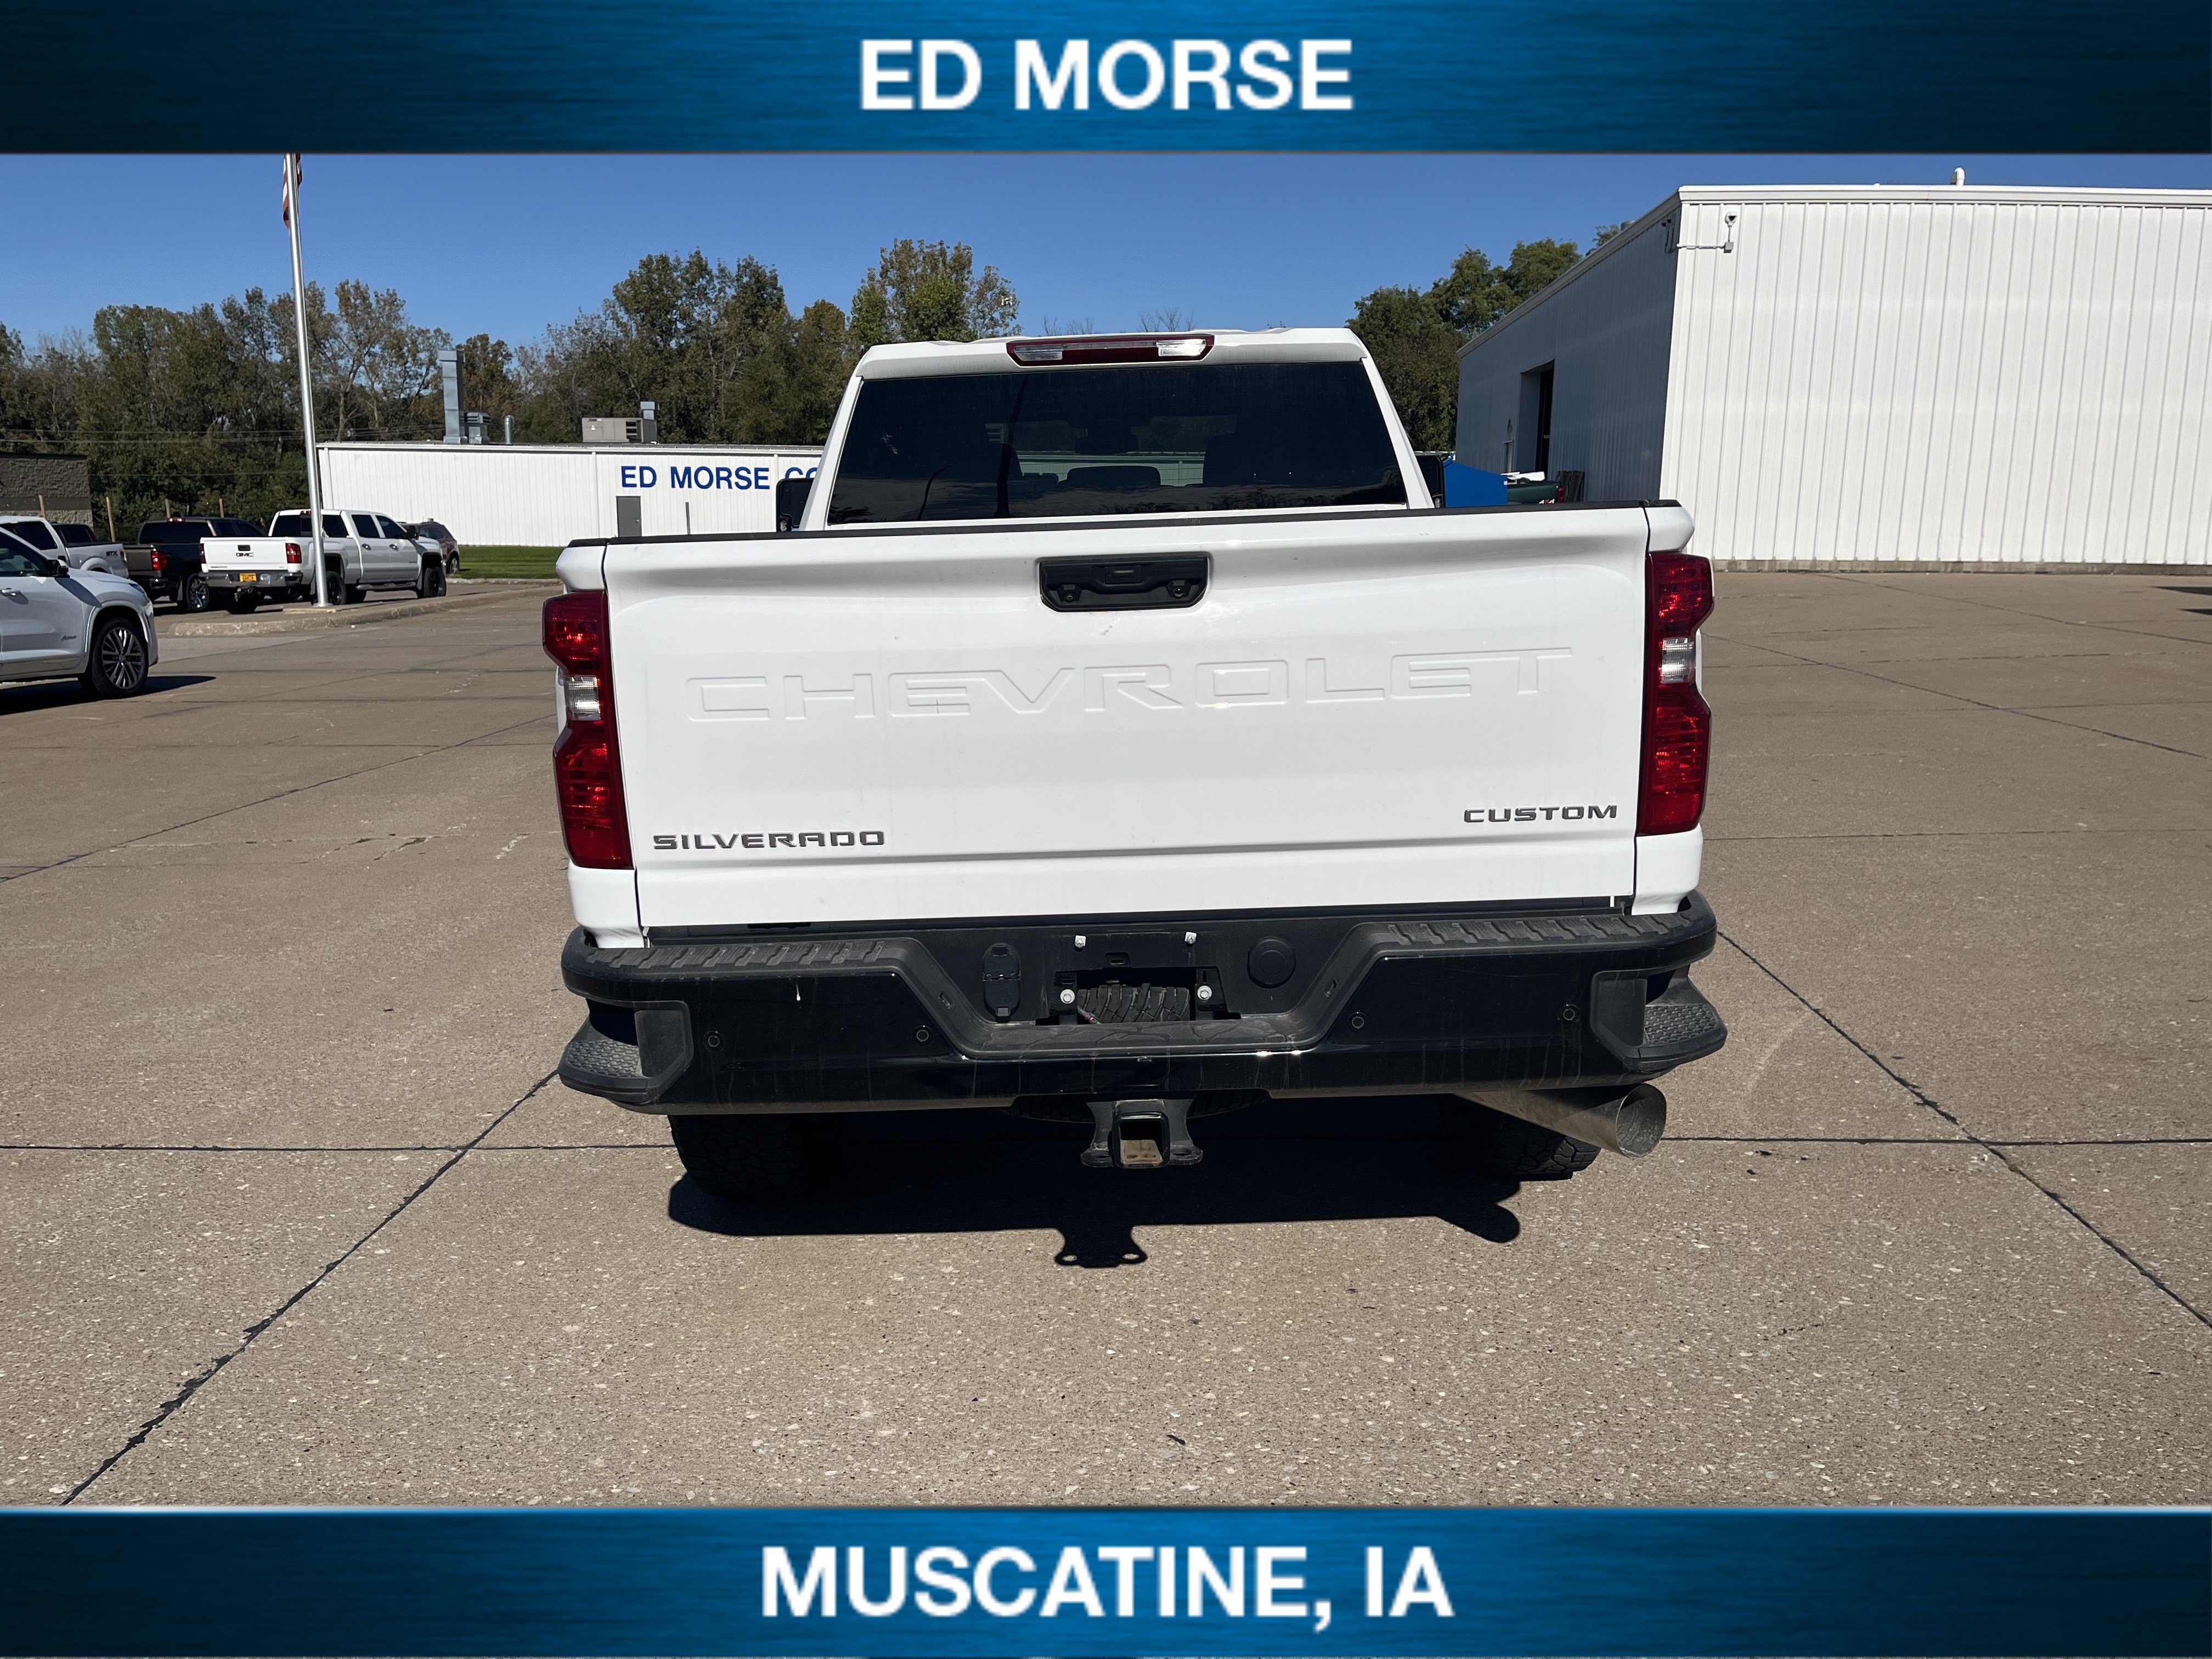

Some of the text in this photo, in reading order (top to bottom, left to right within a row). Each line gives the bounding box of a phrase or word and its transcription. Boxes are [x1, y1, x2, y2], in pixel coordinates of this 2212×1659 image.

[620, 466, 658, 488] ED
[670, 466, 770, 490] MORSE
[686, 646, 1572, 722] CHEVROLET
[1463, 804, 1618, 823] CUSTOM
[652, 830, 885, 850] SILVERADO
